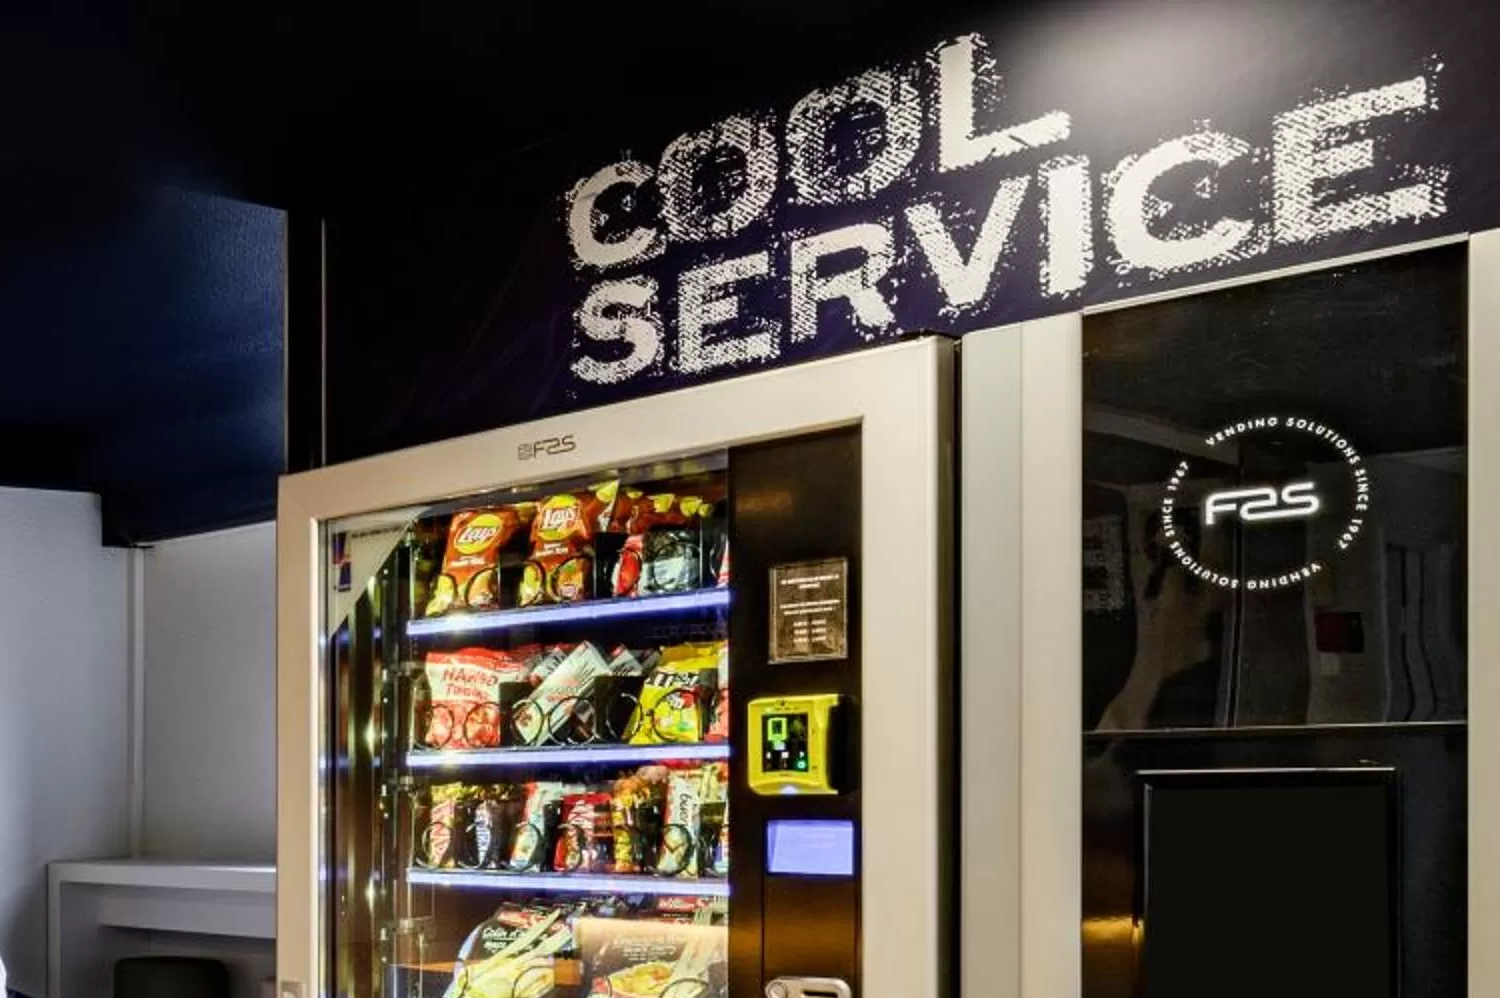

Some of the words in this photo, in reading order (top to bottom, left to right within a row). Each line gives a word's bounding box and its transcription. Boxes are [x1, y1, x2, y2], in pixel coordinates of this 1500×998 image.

[566, 33, 1073, 270] COOL
[568, 60, 1450, 387] SERVICE
[1205, 417, 1278, 446] VENDING
[1285, 417, 1361, 465] SOLUTIONS
[1355, 468, 1369, 511] SINCE
[1162, 498, 1175, 537] SINCE
[1338, 518, 1363, 549] 1967
[1169, 541, 1239, 589] SOLUTIONS
[1247, 562, 1322, 589] VENDING
